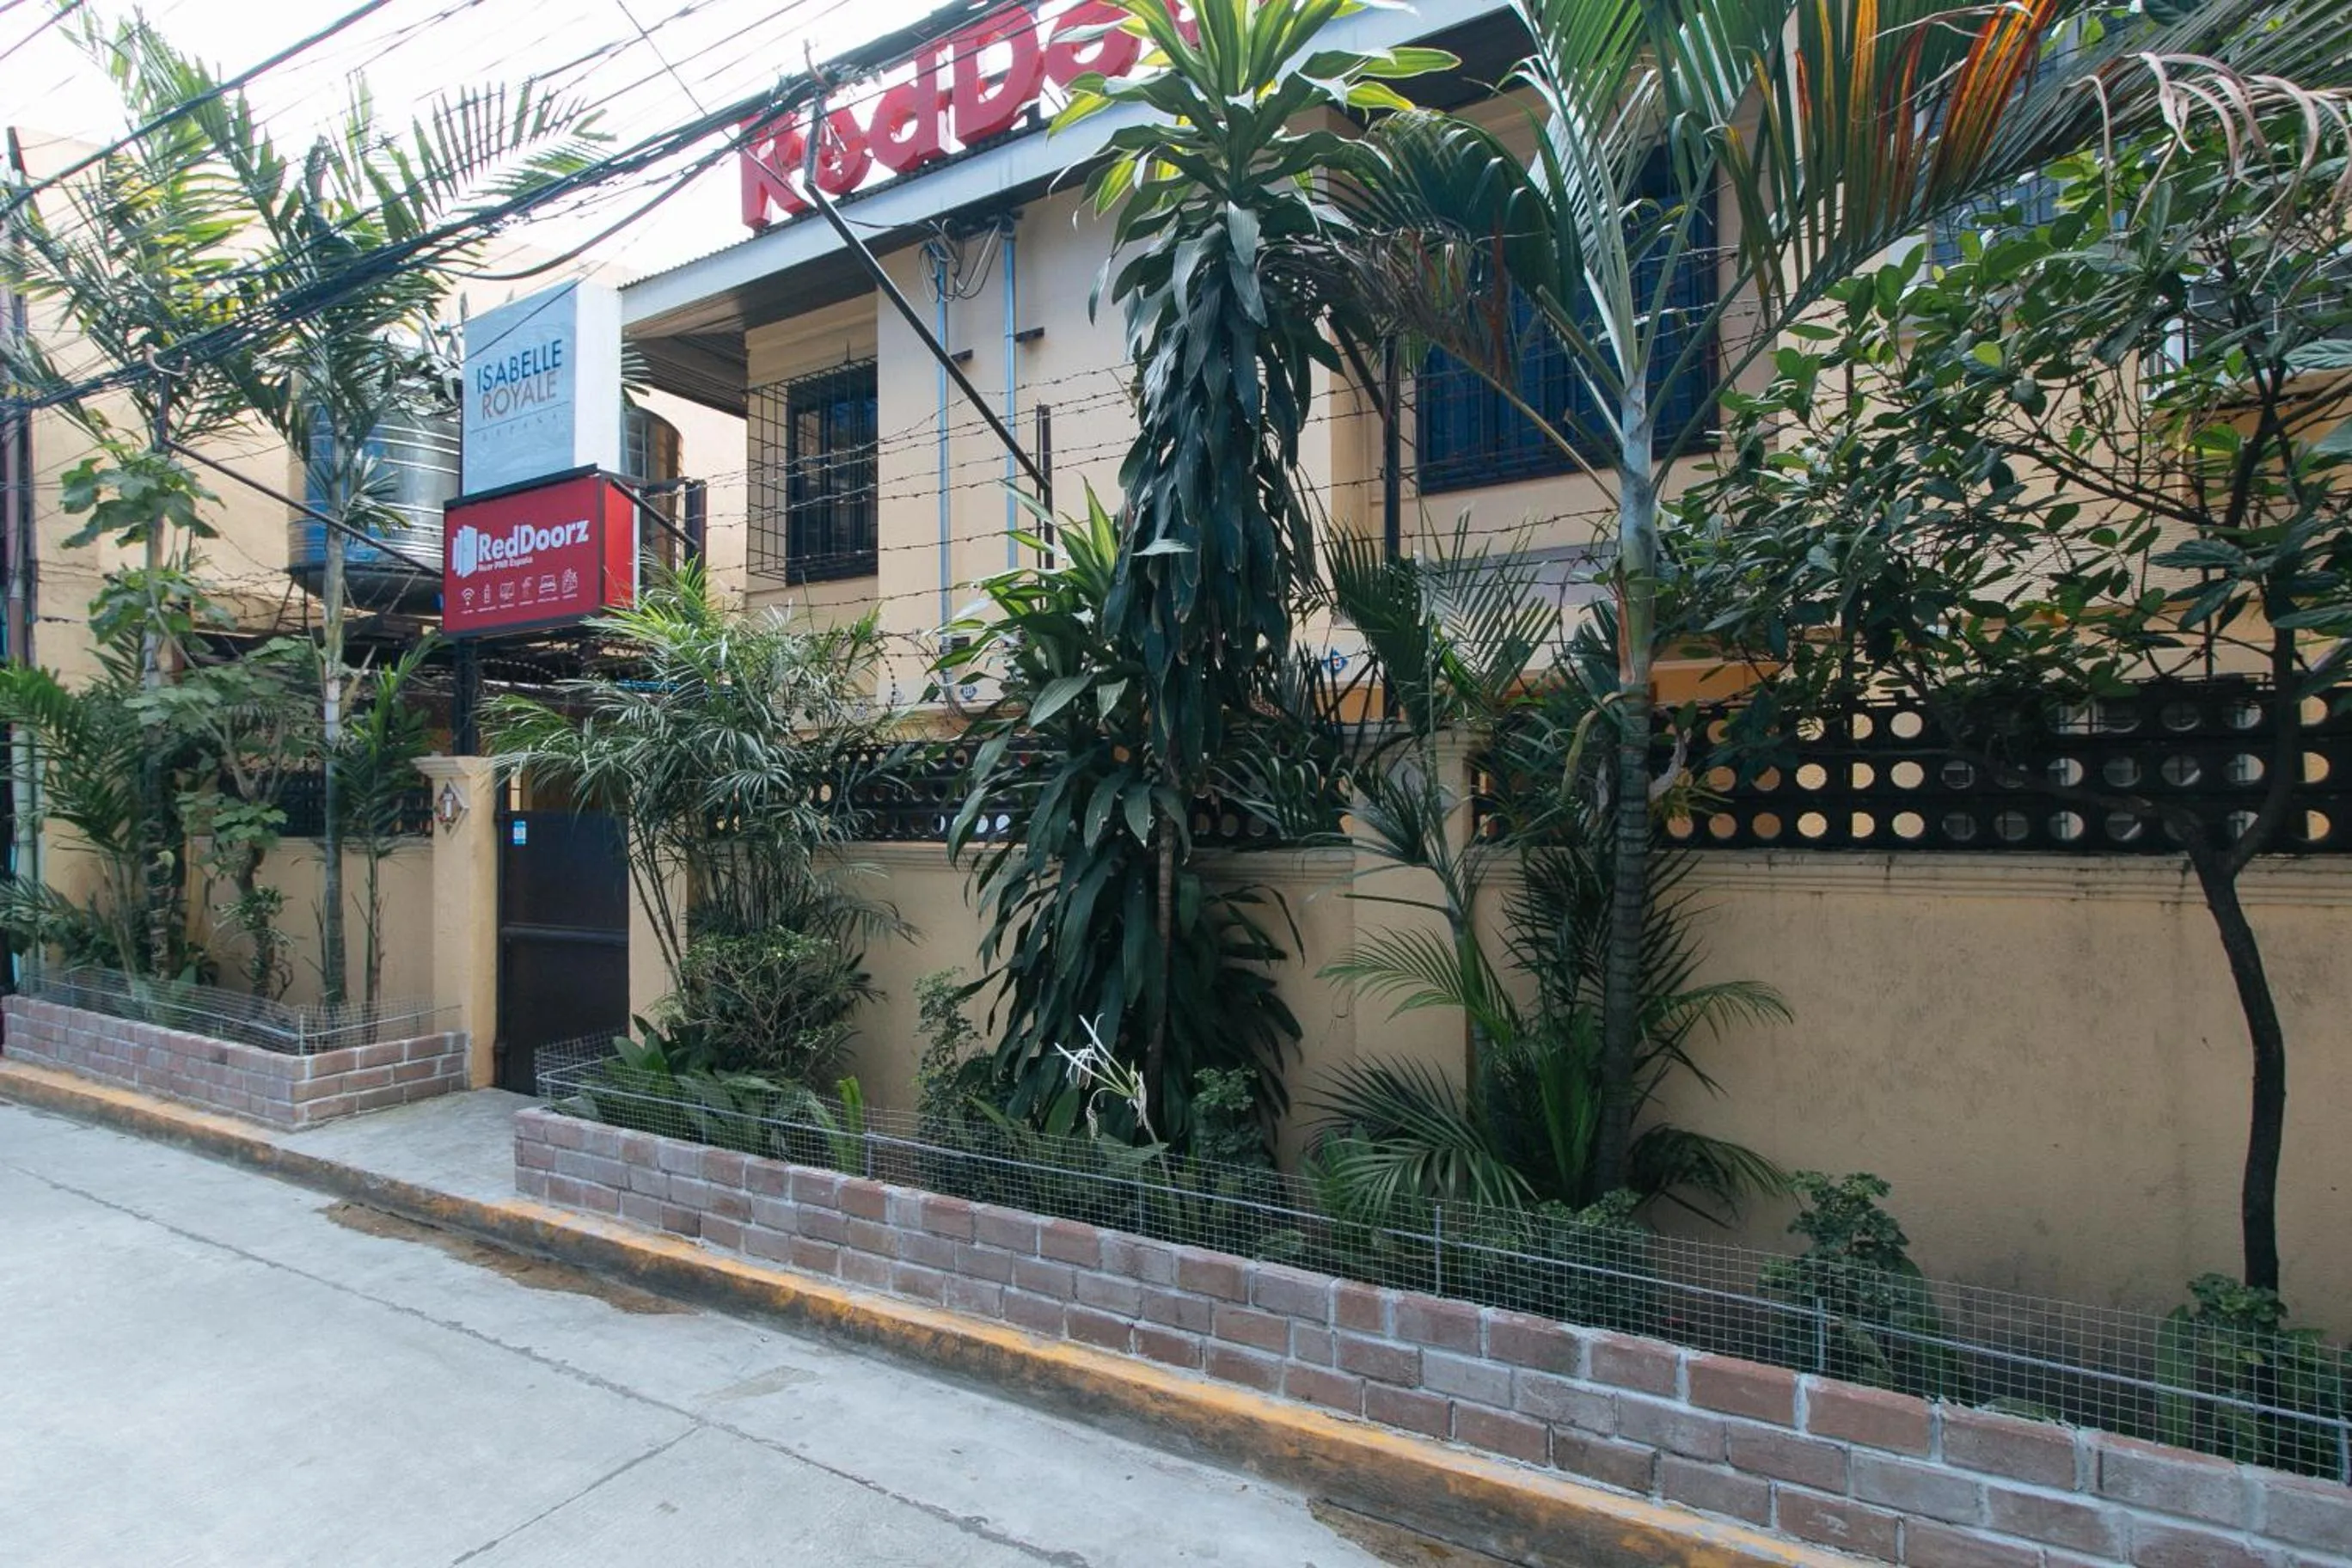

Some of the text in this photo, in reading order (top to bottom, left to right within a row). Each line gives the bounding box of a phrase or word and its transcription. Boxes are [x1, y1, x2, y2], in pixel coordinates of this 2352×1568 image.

[476, 339, 562, 395] ISABELLE
[482, 370, 557, 420] ROYALE
[478, 520, 590, 562] RedDoorz
